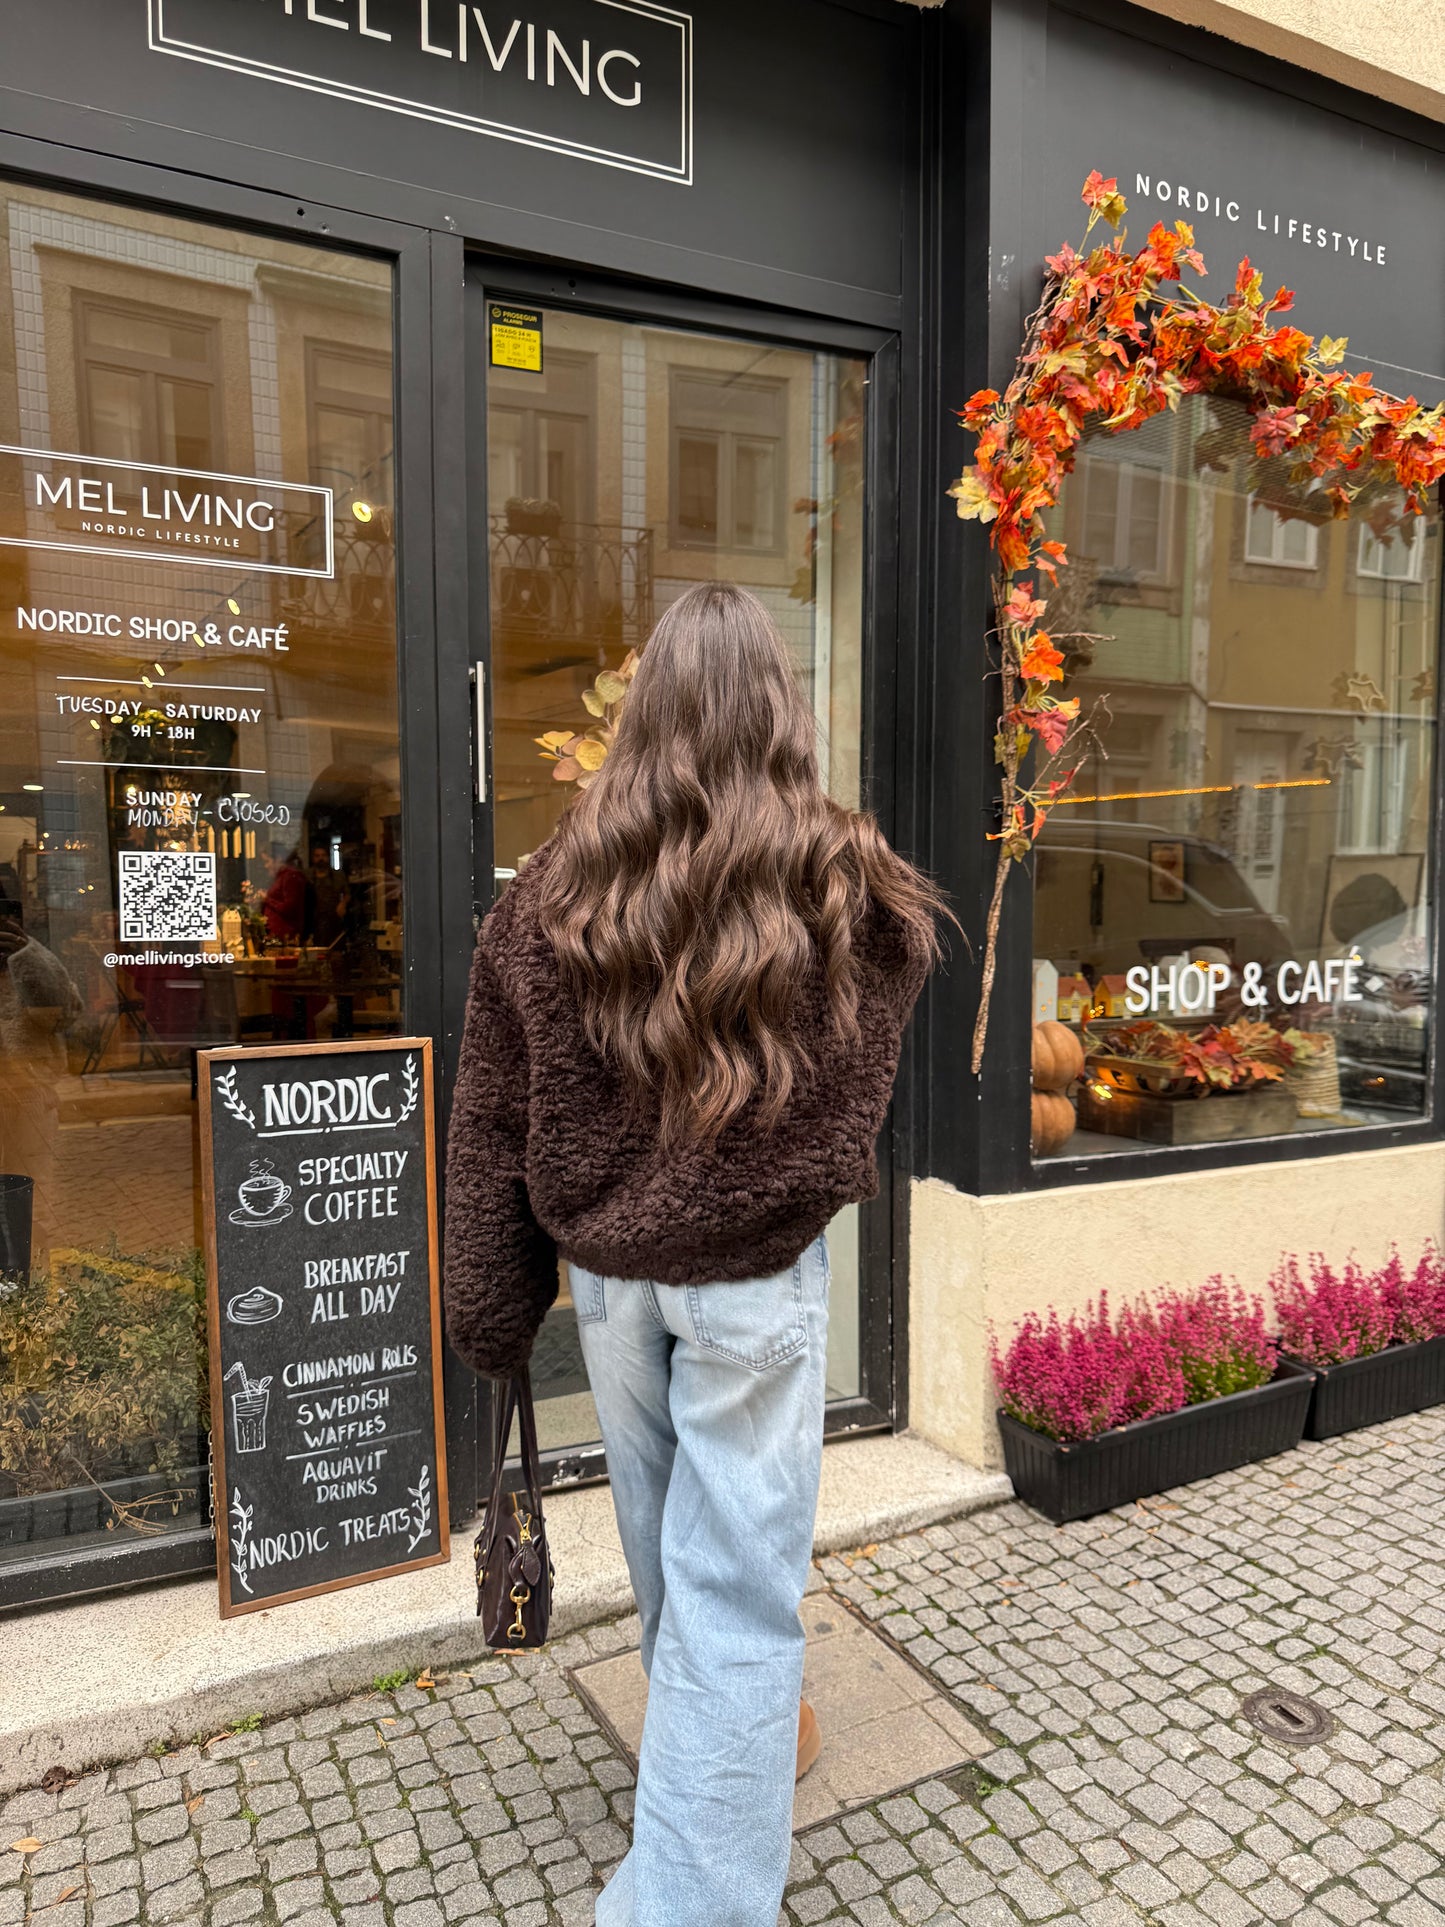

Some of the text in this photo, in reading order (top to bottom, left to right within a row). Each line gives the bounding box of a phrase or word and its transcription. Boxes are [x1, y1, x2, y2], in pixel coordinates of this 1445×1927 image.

[420, 0, 641, 107] LIVING
[1135, 173, 1387, 266] NORDIC LIFESTYLE
[36, 473, 275, 532] MEL LIVING
[82, 521, 240, 548] NORDIC LIFESTYLE
[17, 607, 290, 651] NORDIC SHOP & CAFÉ
[56, 695, 142, 716] TUESDAY
[165, 703, 262, 723] SATURDAY
[131, 725, 151, 738] 9H
[167, 727, 195, 740] 18H
[126, 791, 202, 807] SUNDAY
[128, 808, 198, 833] MONDAY
[103, 950, 235, 968] @mellivingstore
[1124, 945, 1364, 1013] SHOP & CAFÉ
[262, 1073, 392, 1128] NORDIC
[298, 1150, 409, 1186] SPECIALTY
[304, 1186, 399, 1226] COFFEE
[304, 1250, 410, 1289] BREAKFAST
[310, 1282, 401, 1324] ALL DAY
[381, 1344, 418, 1369] ROLLS
[303, 1415, 387, 1449] WAFFLES
[338, 1508, 412, 1546] TREATS
